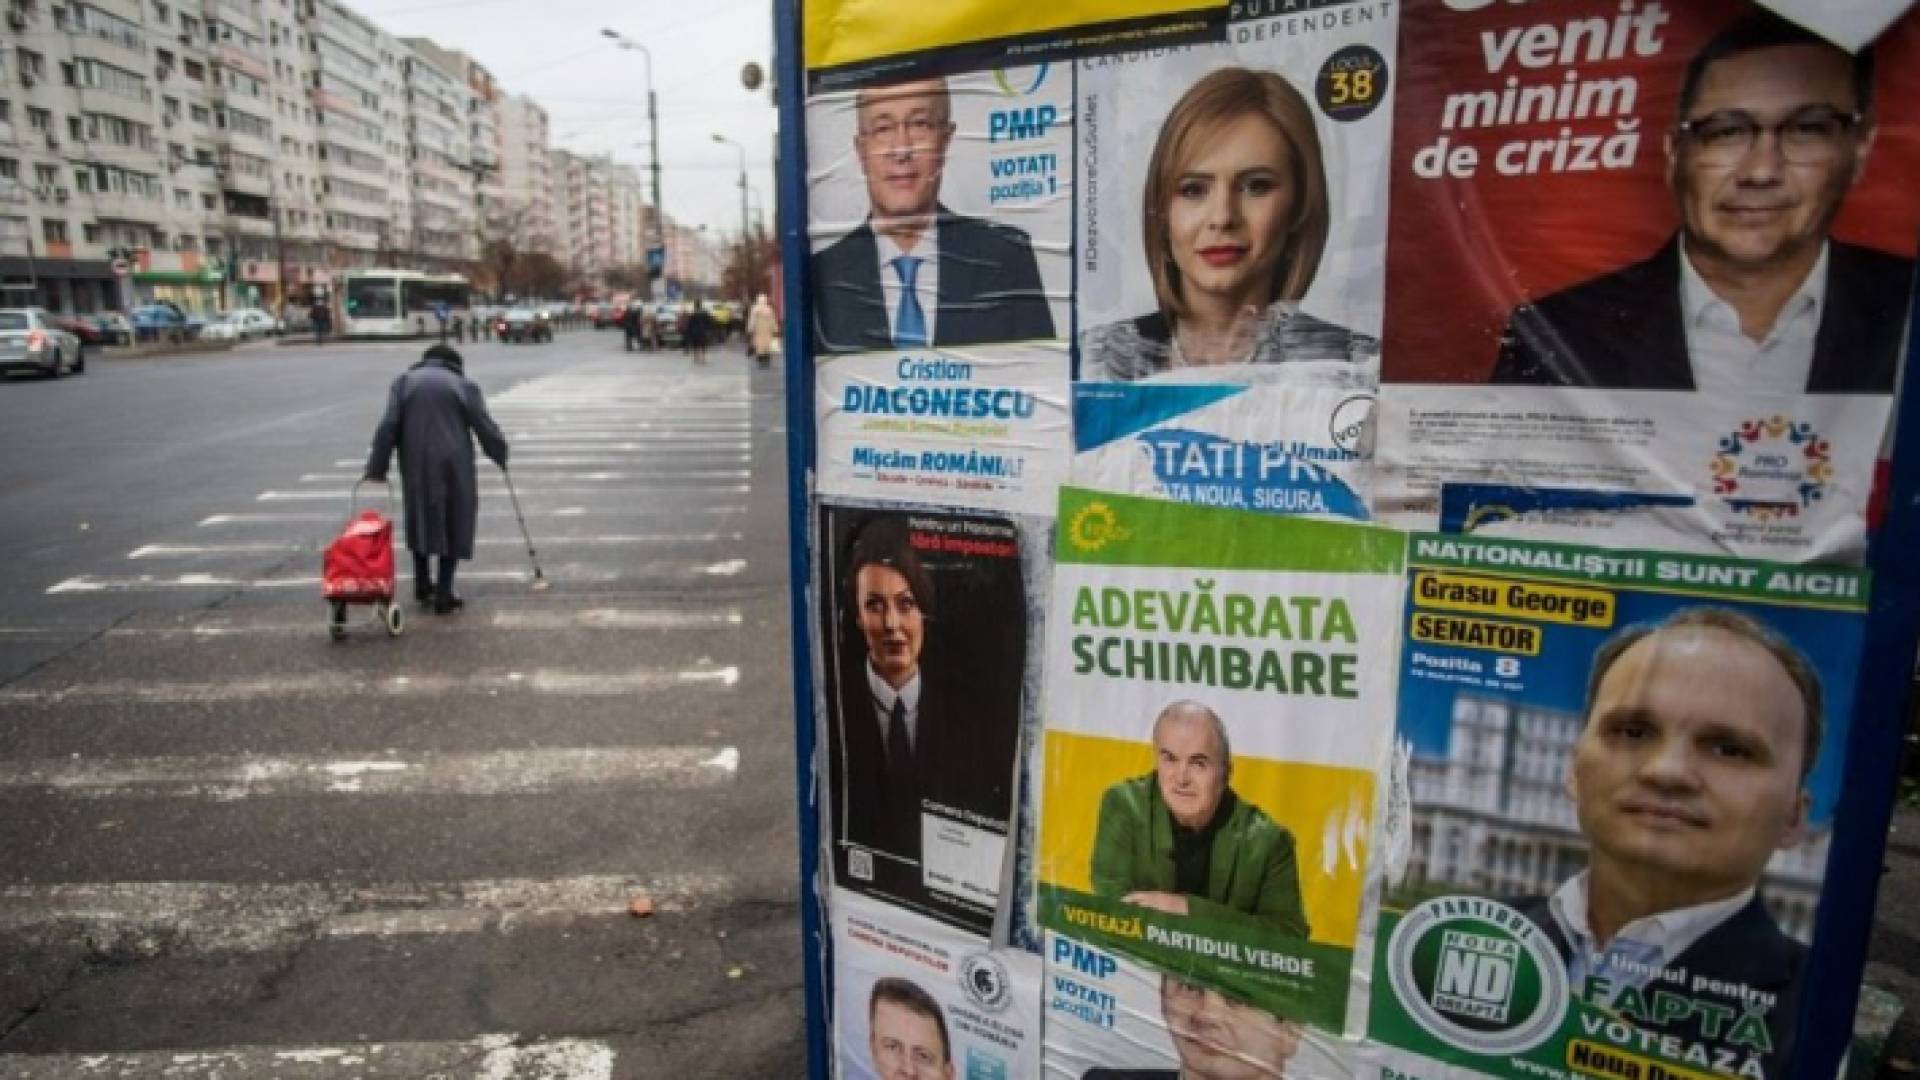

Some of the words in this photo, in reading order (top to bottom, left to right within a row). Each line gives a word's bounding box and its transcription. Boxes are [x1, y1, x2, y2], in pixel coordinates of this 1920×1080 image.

[1480, 0, 1670, 73] venit
[1330, 69, 1375, 104] 38
[1441, 70, 1638, 130] minim
[990, 105, 1057, 143] PMP
[1411, 136, 1478, 179] de
[1496, 118, 1641, 175] criză
[1047, 175, 1057, 195] 1
[899, 357, 972, 381] Cristian
[843, 384, 1034, 419] DIACONESCU
[1655, 559, 1759, 588] SUNT
[1072, 577, 1358, 643] ADEVĂRATA
[1421, 576, 1497, 606] Grasu
[1507, 584, 1607, 622] George
[1416, 615, 1534, 652] SENATOR
[1072, 634, 1359, 698] SCHIMBARE
[1495, 658, 1521, 687] 8
[1430, 899, 1534, 940] PARTIDUL
[1053, 938, 1119, 978] PMP
[1147, 925, 1242, 964] PARTIDUL
[1244, 944, 1316, 979] VERDE
[1446, 932, 1515, 954] NOUA
[1440, 949, 1511, 1001] ND
[1692, 973, 1778, 1008] pentru
[1584, 973, 1774, 1054] FAPTĂ
